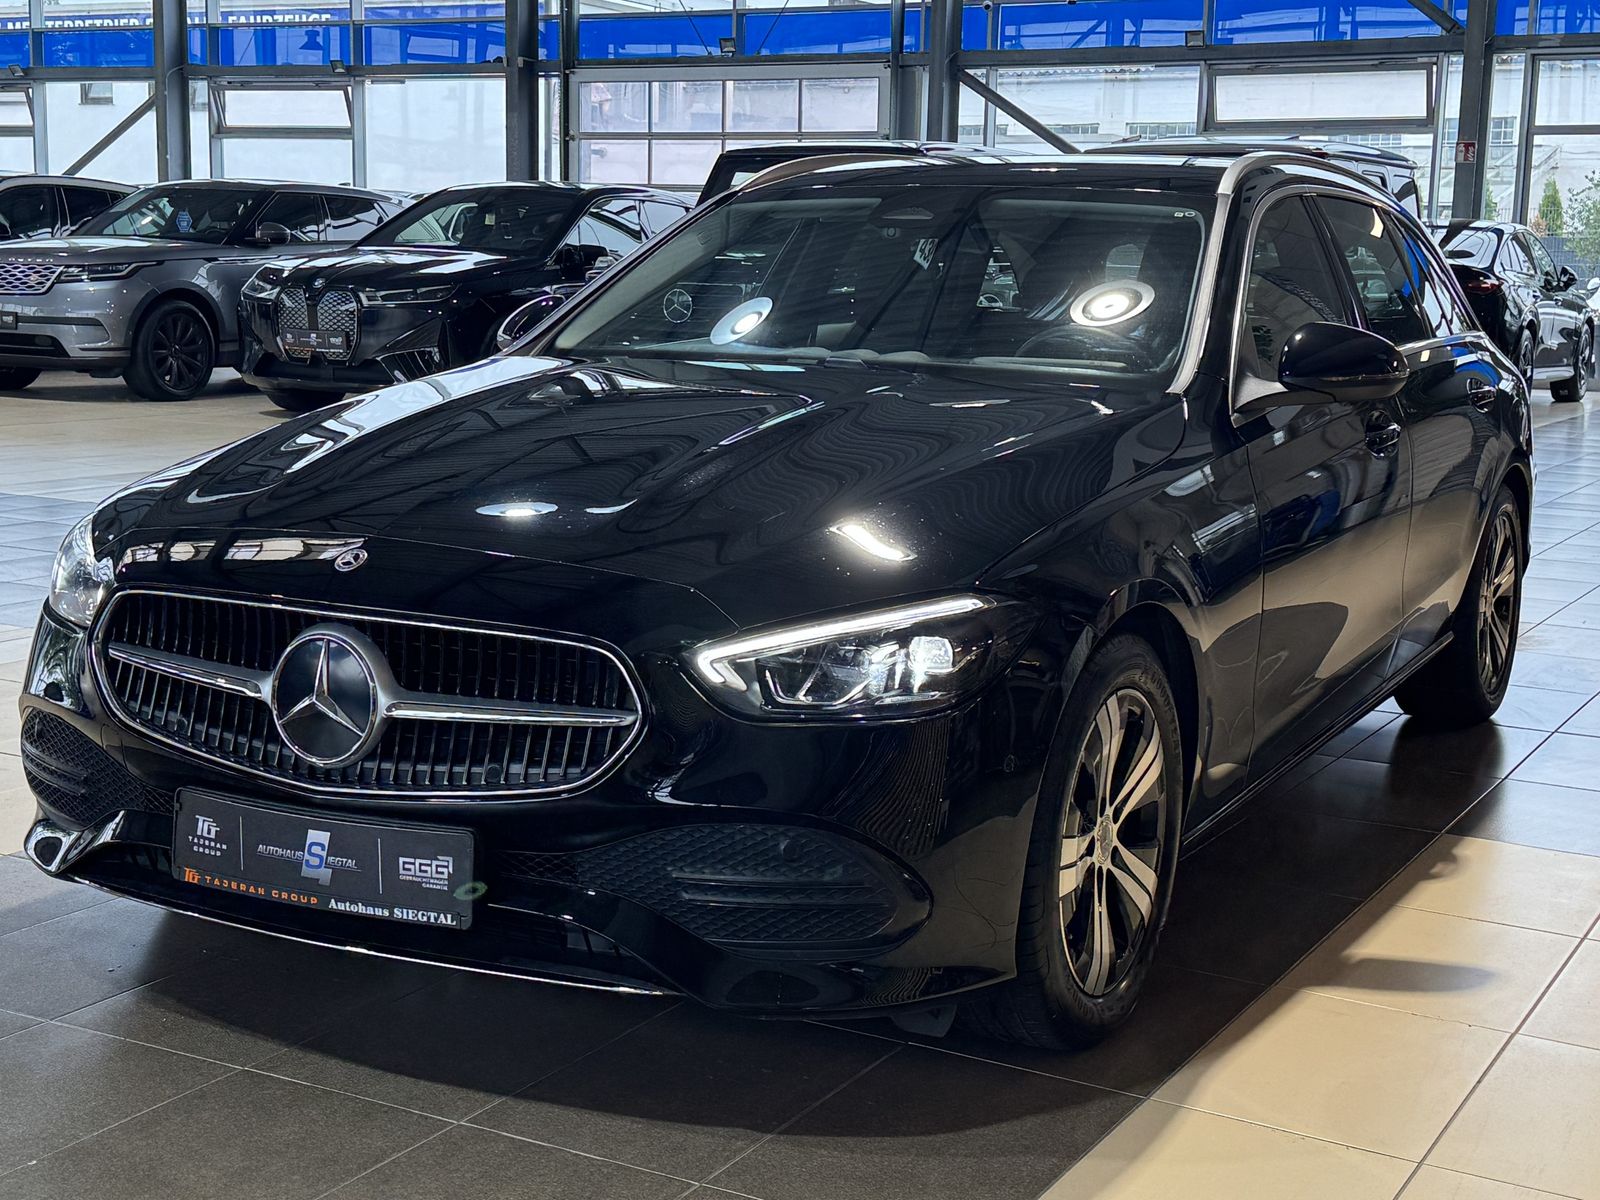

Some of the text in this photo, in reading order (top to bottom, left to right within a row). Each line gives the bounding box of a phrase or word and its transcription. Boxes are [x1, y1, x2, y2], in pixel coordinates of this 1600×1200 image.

[193, 845, 222, 857] GROUP
[257, 844, 304, 861] AUTOHAUS
[399, 856, 450, 879] GGG
[204, 875, 265, 895] TAJERAN
[271, 889, 318, 905] GROUP
[328, 898, 457, 926] Autohaus SIEGTAL
